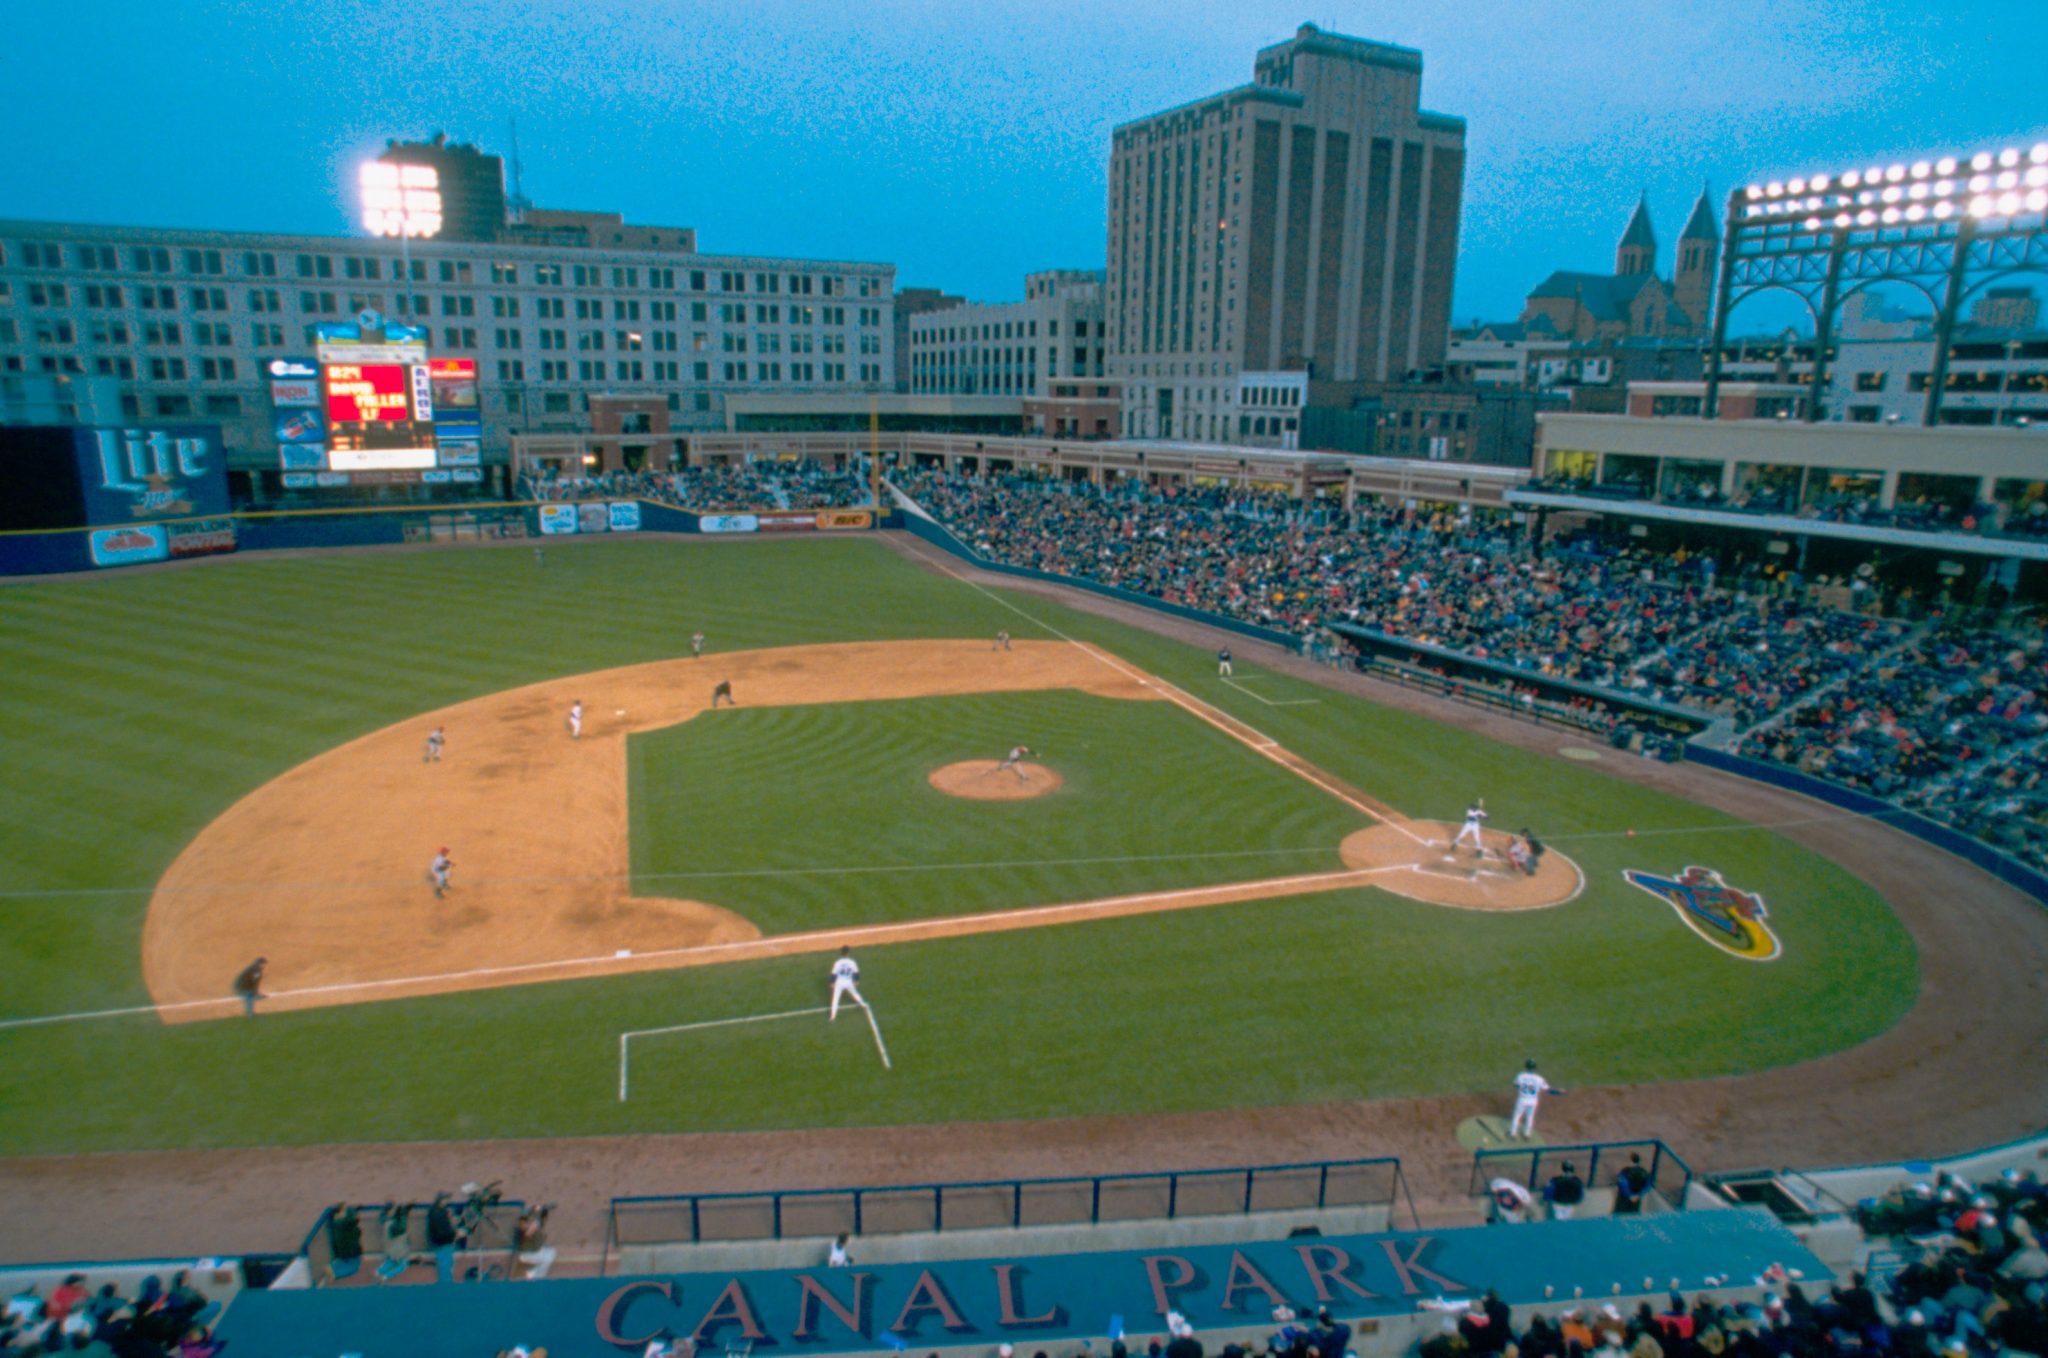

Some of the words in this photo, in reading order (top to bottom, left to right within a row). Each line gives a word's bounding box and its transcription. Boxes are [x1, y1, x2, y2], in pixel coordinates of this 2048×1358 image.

[94, 429, 209, 493] Lite
[833, 514, 864, 526] BIC
[594, 1264, 1057, 1346] CANAL
[1137, 1236, 1468, 1315] PARK
